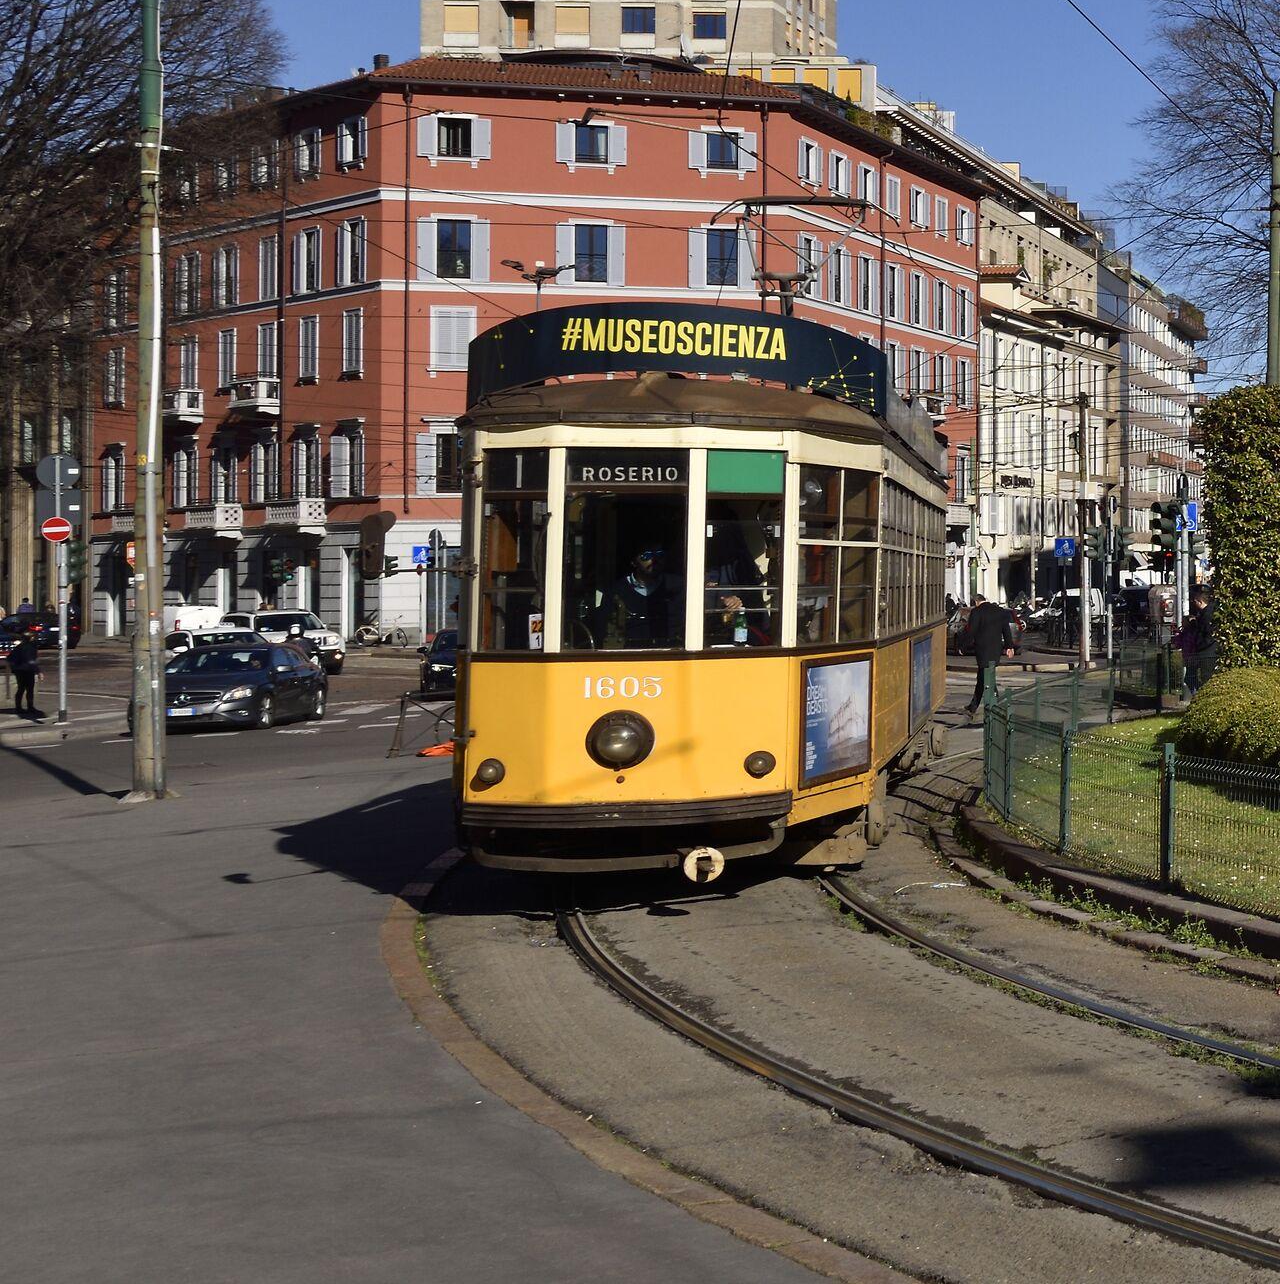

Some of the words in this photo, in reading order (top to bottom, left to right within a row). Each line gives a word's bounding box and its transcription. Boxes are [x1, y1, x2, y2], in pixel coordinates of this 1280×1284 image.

[561, 317, 787, 361] #MUSEOSCIENZA
[582, 466, 679, 482] ROSERIO
[584, 676, 663, 699] 1605
